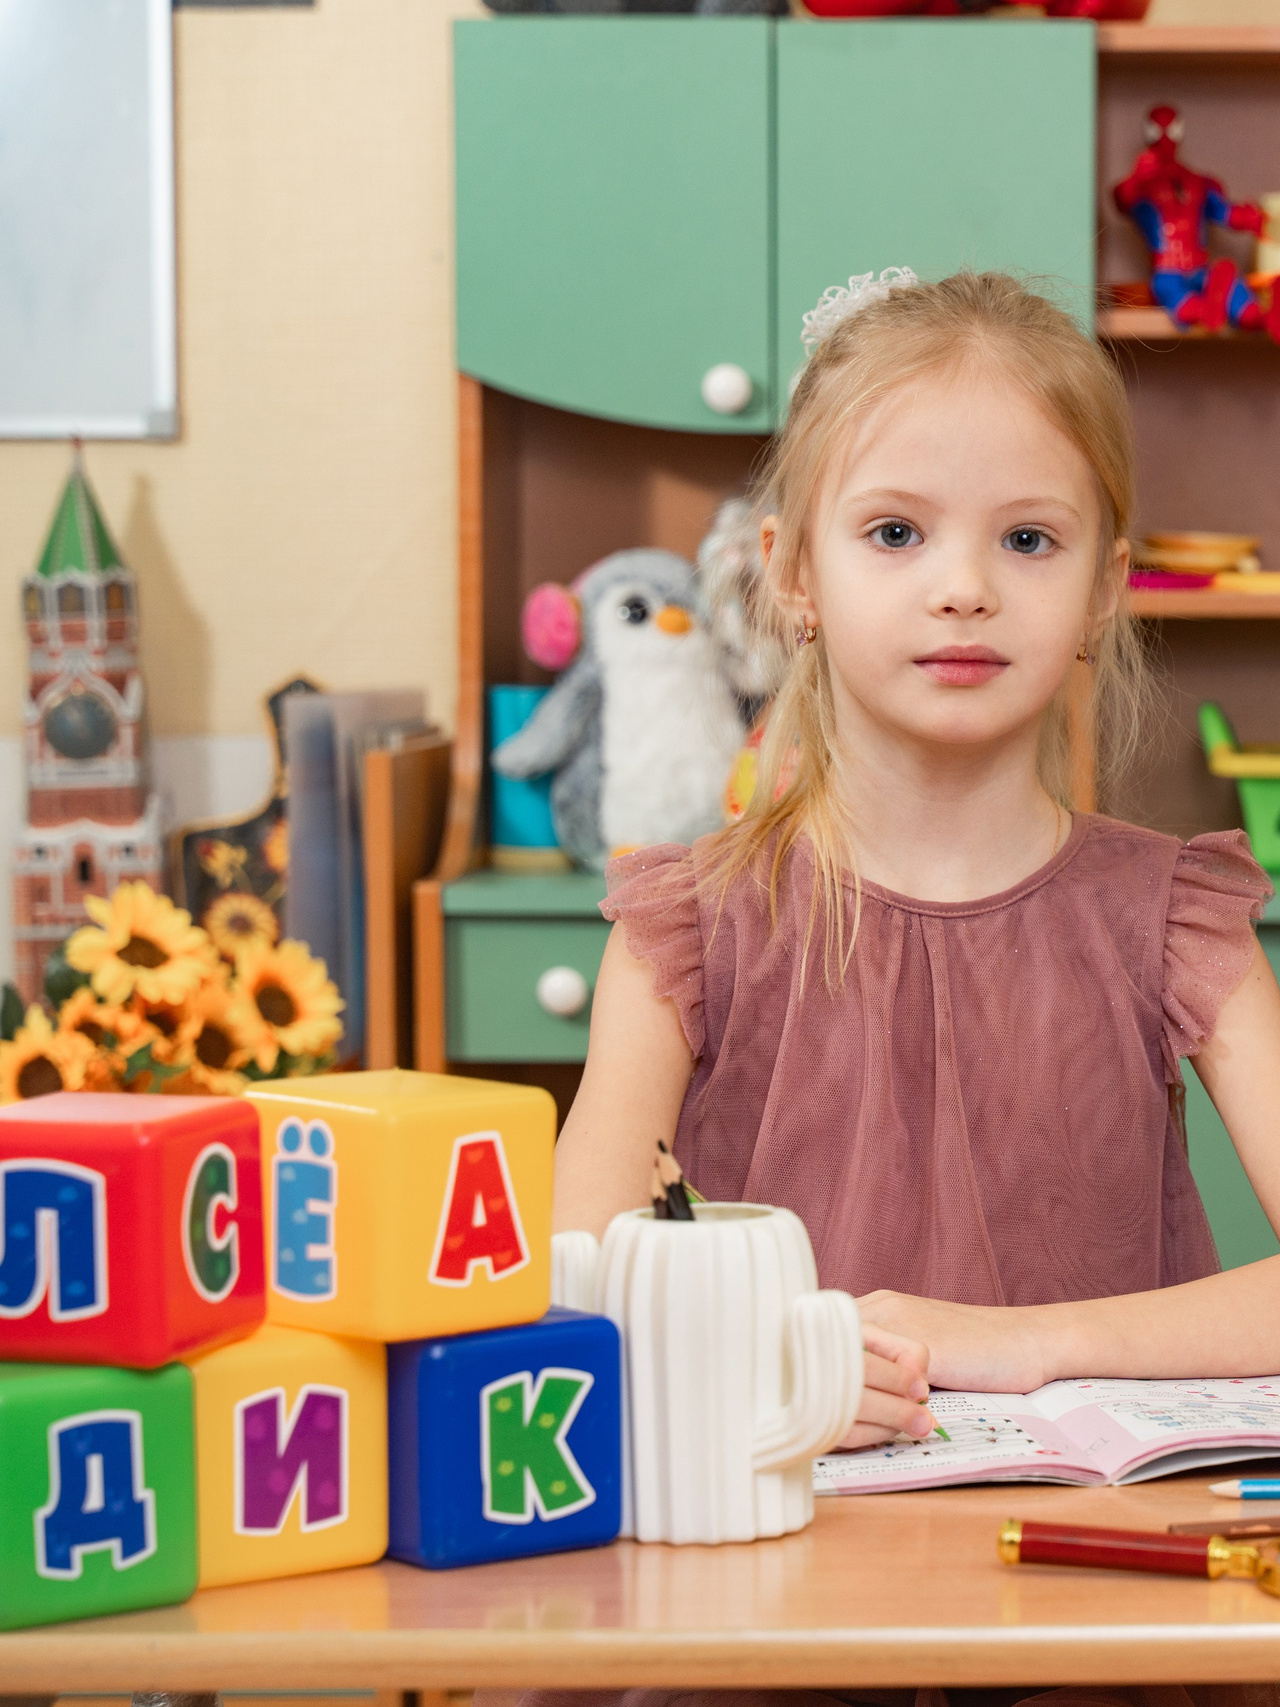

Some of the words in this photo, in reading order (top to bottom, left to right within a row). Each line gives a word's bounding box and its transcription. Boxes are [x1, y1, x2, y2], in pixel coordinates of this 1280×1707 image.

[0, 1157, 108, 1322] Л
[181, 1143, 240, 1302] С
[272, 1116, 337, 1302] Ё
[429, 1131, 530, 1287] А
[33, 1409, 157, 1579] Д
[234, 1384, 348, 1535] И
[480, 1367, 596, 1523] К
